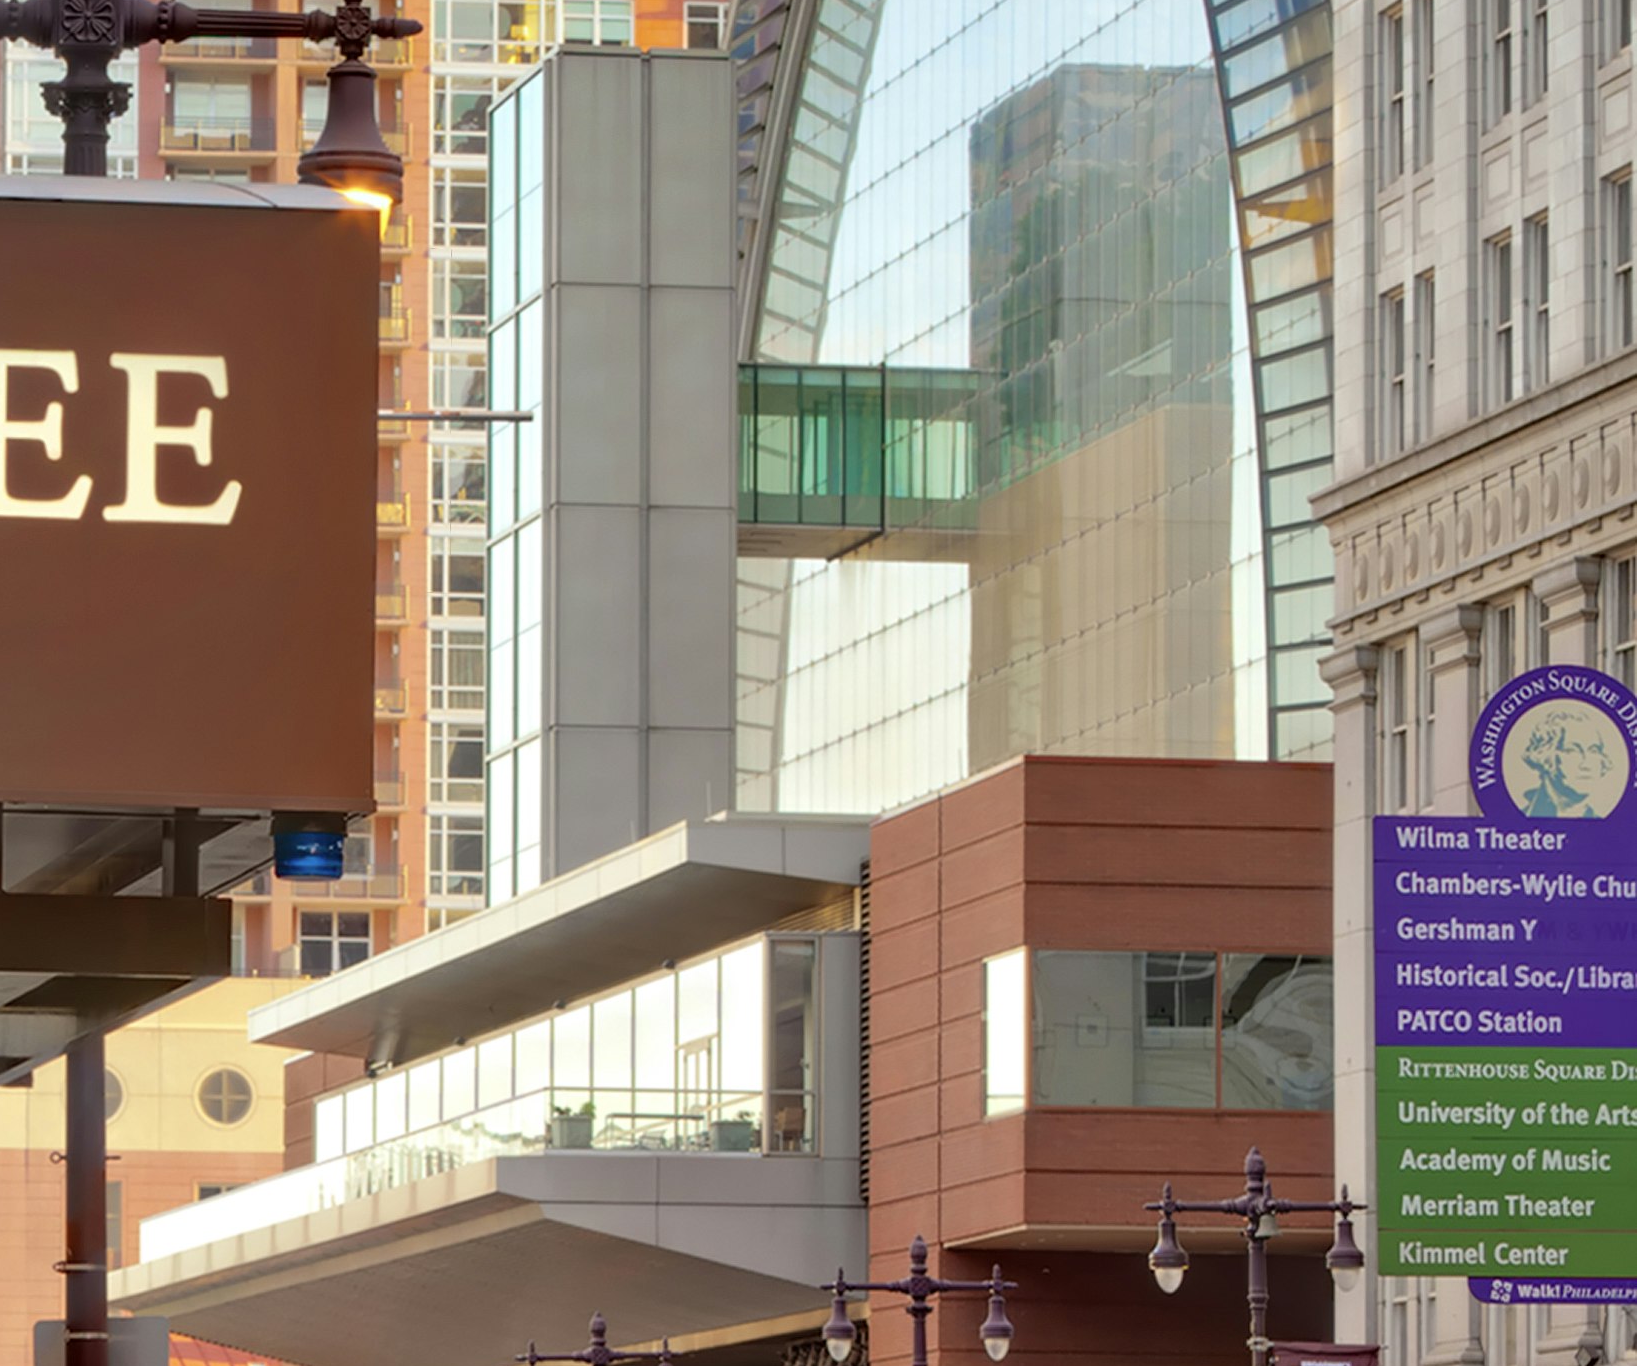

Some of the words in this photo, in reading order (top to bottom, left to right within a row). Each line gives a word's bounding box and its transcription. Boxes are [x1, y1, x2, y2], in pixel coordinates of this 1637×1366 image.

[1476, 679, 1546, 789] WASHINGTON
[1548, 669, 1620, 708] SQUARE
[1396, 826, 1469, 849] Wilma
[1476, 827, 1566, 850] Theater
[1395, 872, 1587, 902] Chambers-Wylie
[1592, 876, 1637, 898] Chu
[1397, 917, 1515, 940] Gershman
[1521, 919, 1538, 940] Y
[1397, 964, 1508, 987] Historical
[1514, 965, 1637, 994] Soc./Libra
[1397, 1010, 1472, 1032] PATCO
[1478, 1010, 1562, 1033] Station
[1398, 1057, 1529, 1079] RITTENHOUSE
[1534, 1059, 1606, 1082] SQUARE
[1398, 1101, 1515, 1129] University
[1522, 1103, 1547, 1125] of
[1551, 1102, 1589, 1125] the
[1595, 1104, 1637, 1126] Arts
[1400, 1148, 1506, 1176] Academy
[1512, 1149, 1536, 1171] of
[1542, 1149, 1611, 1171] Music
[1401, 1194, 1499, 1216] Merriam
[1505, 1195, 1595, 1217] Theater
[1399, 1241, 1486, 1264] Kimmel
[1494, 1243, 1569, 1265] Center
[1563, 1285, 1637, 1299] PHILADELP
